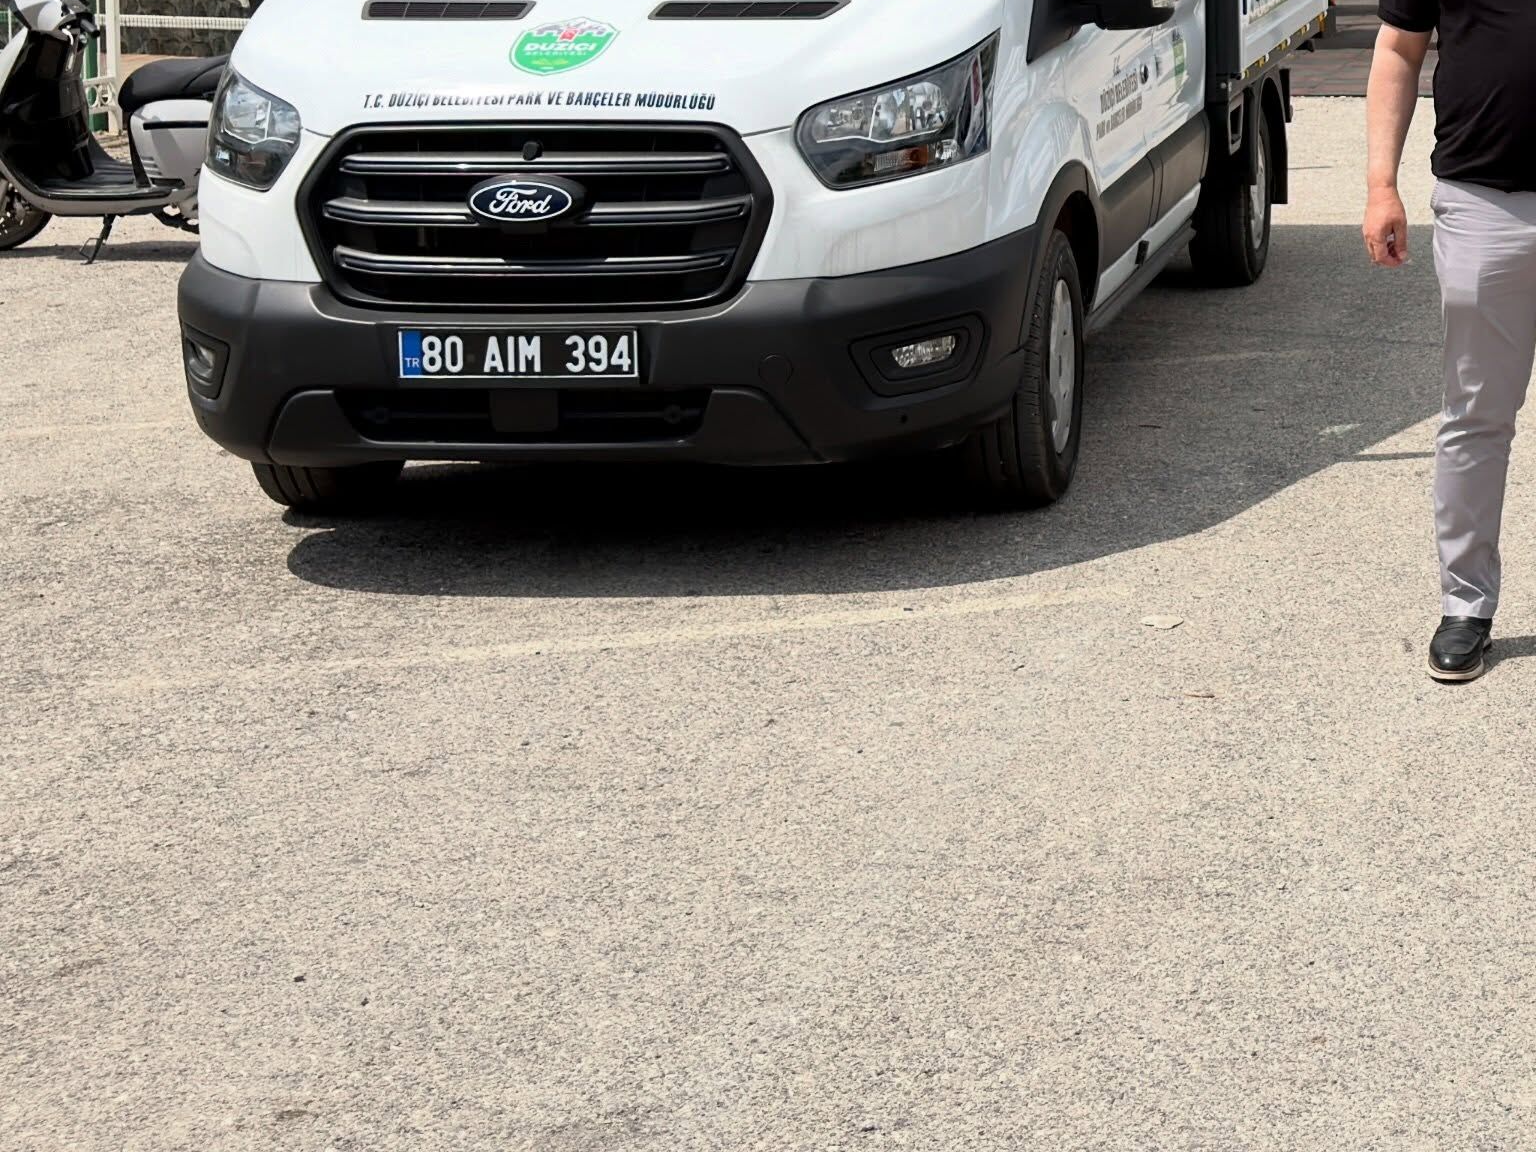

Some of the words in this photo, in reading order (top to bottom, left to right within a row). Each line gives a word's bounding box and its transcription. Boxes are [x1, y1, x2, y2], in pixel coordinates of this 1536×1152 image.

[507, 91, 544, 106] PARK
[547, 91, 565, 106] VE
[566, 91, 632, 108] BAHÇELER
[634, 90, 716, 111] MÜDÜRLÜĞÜ
[488, 186, 553, 213] Ford
[405, 358, 420, 368] TR
[421, 335, 464, 373] 80
[483, 335, 542, 373] AIM
[565, 335, 632, 374] 394
